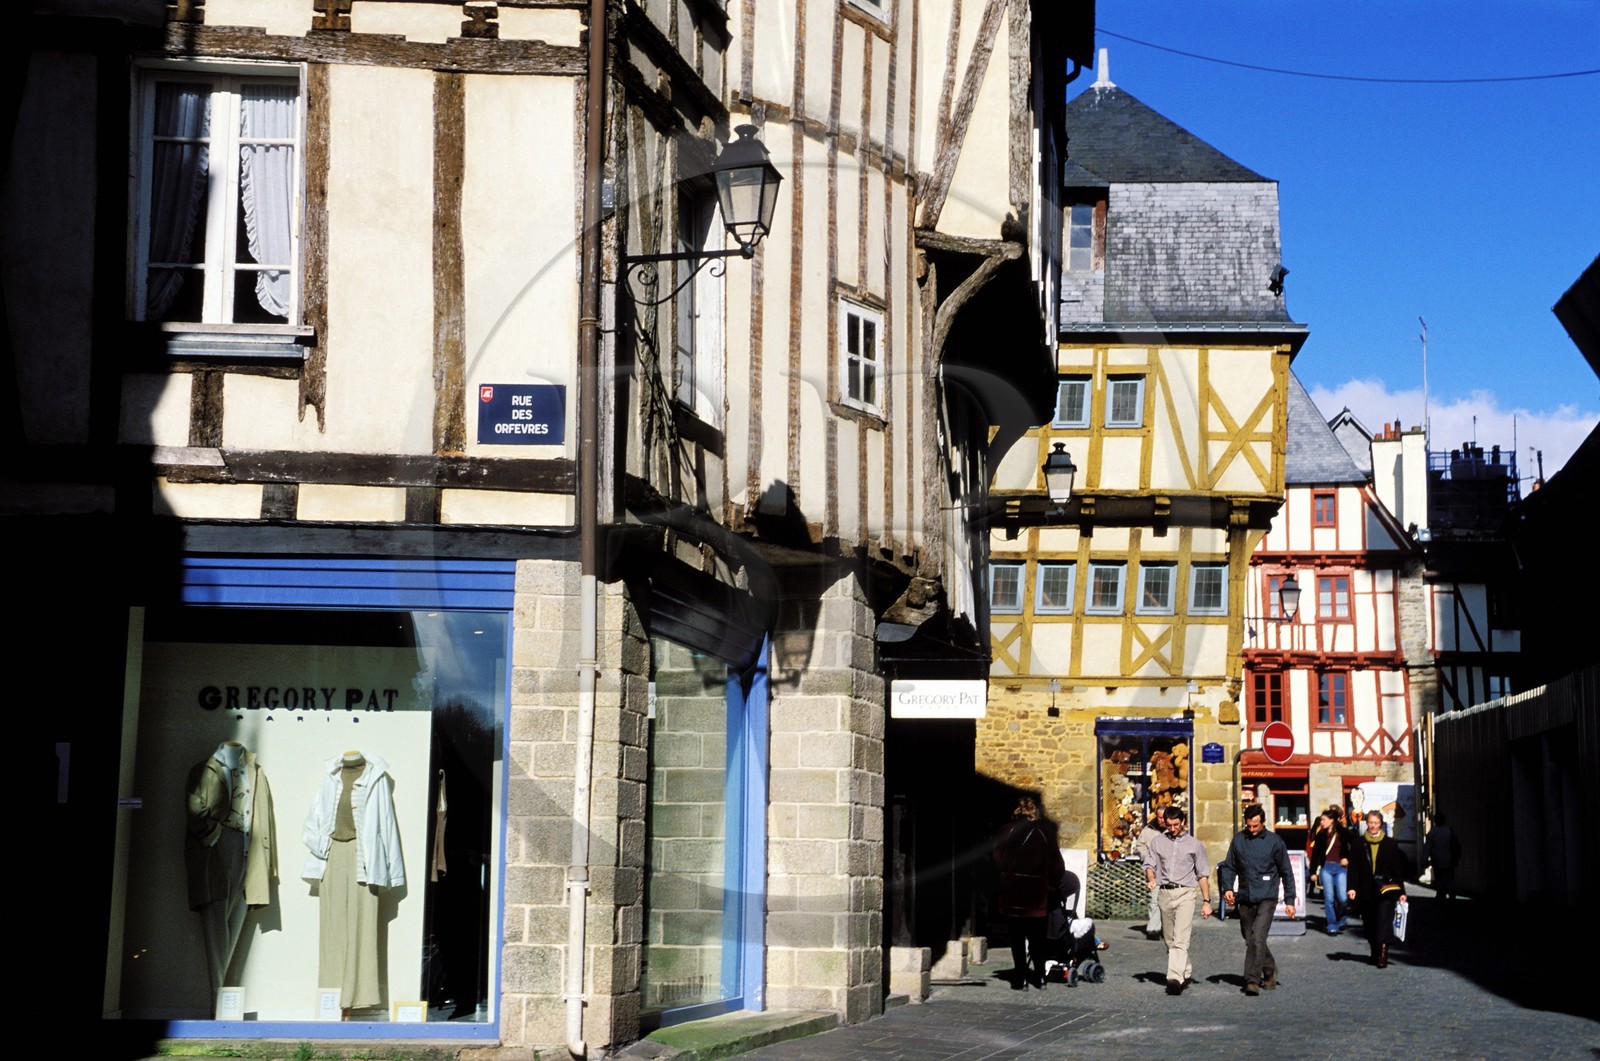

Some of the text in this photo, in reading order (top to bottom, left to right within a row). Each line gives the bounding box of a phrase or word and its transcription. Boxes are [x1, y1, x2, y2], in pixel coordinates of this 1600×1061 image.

[511, 395, 533, 406] RUE
[511, 409, 533, 420] DES
[494, 423, 549, 435] ORFEVRES
[198, 686, 398, 712] GREGORY PAT
